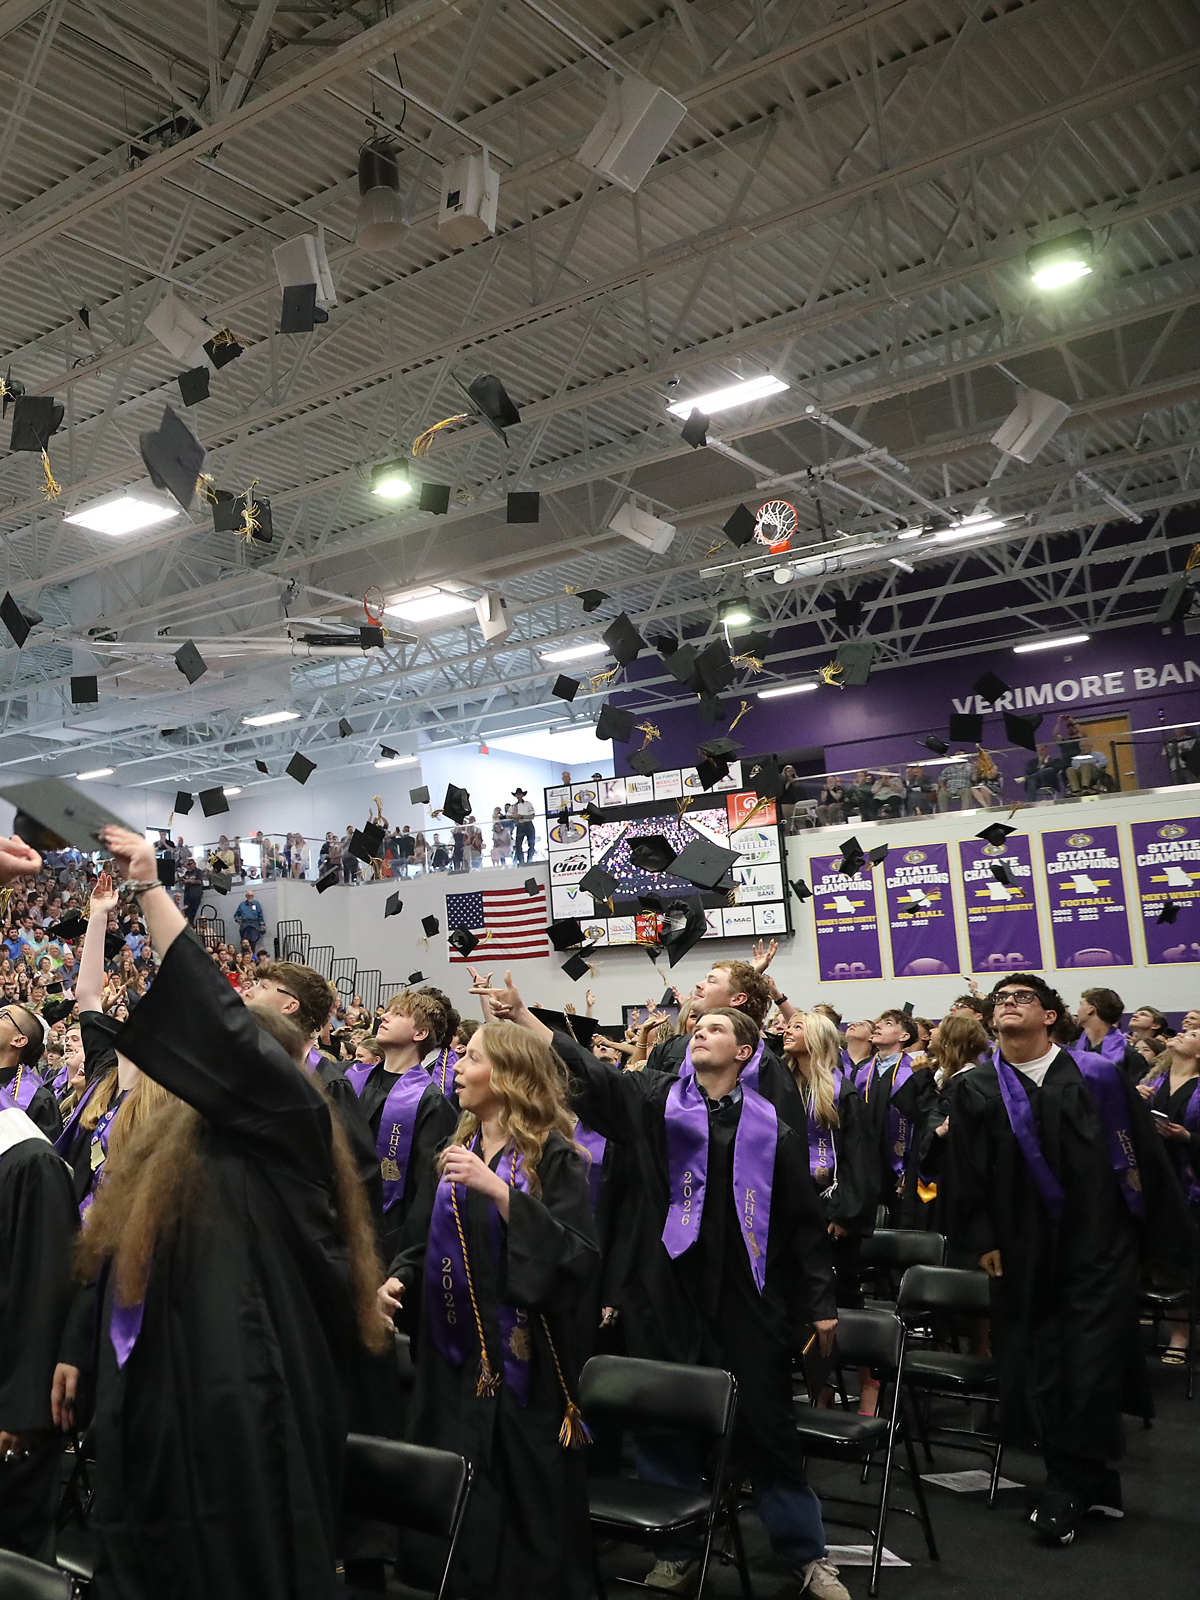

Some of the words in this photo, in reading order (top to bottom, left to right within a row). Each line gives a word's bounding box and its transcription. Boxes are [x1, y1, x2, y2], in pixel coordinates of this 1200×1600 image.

[952, 671, 1125, 714] VERIMORE
[733, 839, 777, 850] SHELLER
[1147, 839, 1200, 854] STATE
[1056, 848, 1107, 862] STATE
[552, 862, 587, 873] Club
[894, 864, 939, 877] STATE
[1047, 857, 1119, 875] CHAMPIONS
[741, 884, 775, 893] VERIMORE
[813, 880, 873, 896] CHAMPIONS
[886, 872, 950, 889] CHAMPIONS
[1060, 897, 1115, 907] FOOTBALL
[388, 1122, 402, 1157] KHS
[1116, 1129, 1137, 1166] KHS
[817, 1137, 827, 1166] KHS
[681, 1171, 693, 1226] 2026
[743, 1187, 756, 1229] KHS
[441, 1257, 457, 1325] 2026
